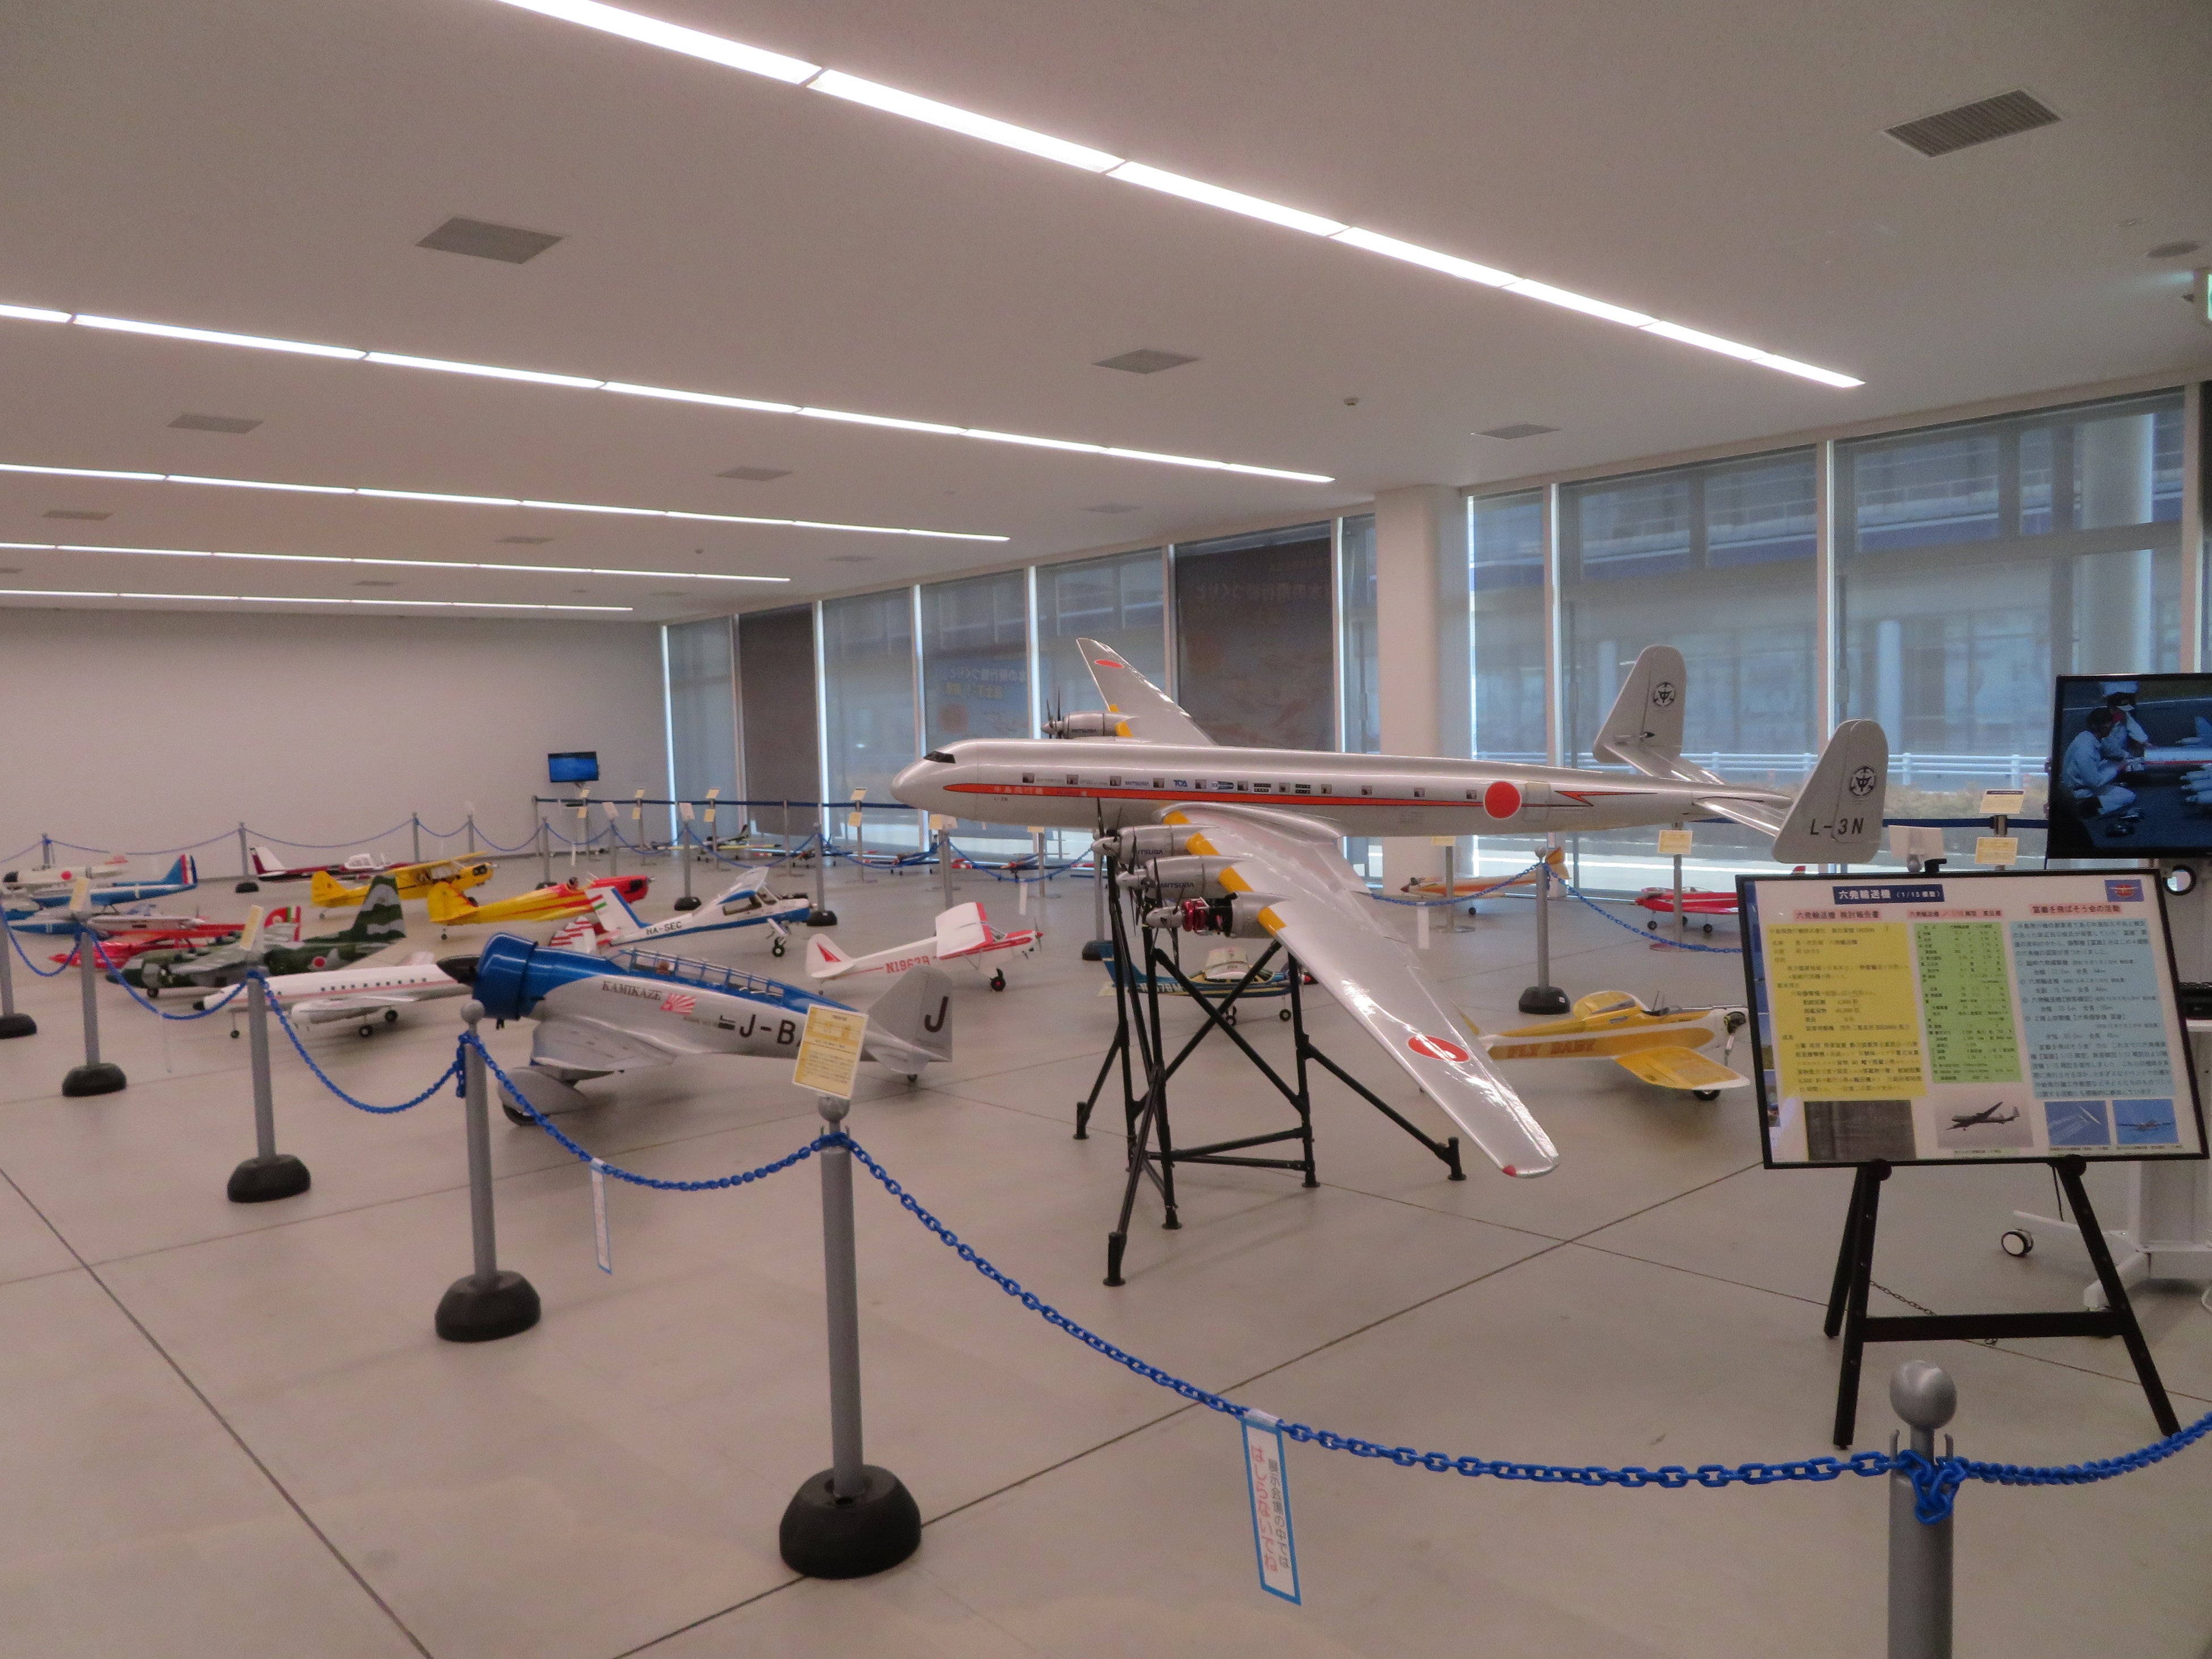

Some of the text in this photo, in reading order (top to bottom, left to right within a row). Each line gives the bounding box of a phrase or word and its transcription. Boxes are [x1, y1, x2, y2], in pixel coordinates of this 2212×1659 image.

[1810, 817, 1864, 835] L-3N
[1838, 889, 1892, 900] 六発輸送機
[601, 981, 663, 1001] KAMIKAZE
[924, 995, 949, 1033] J
